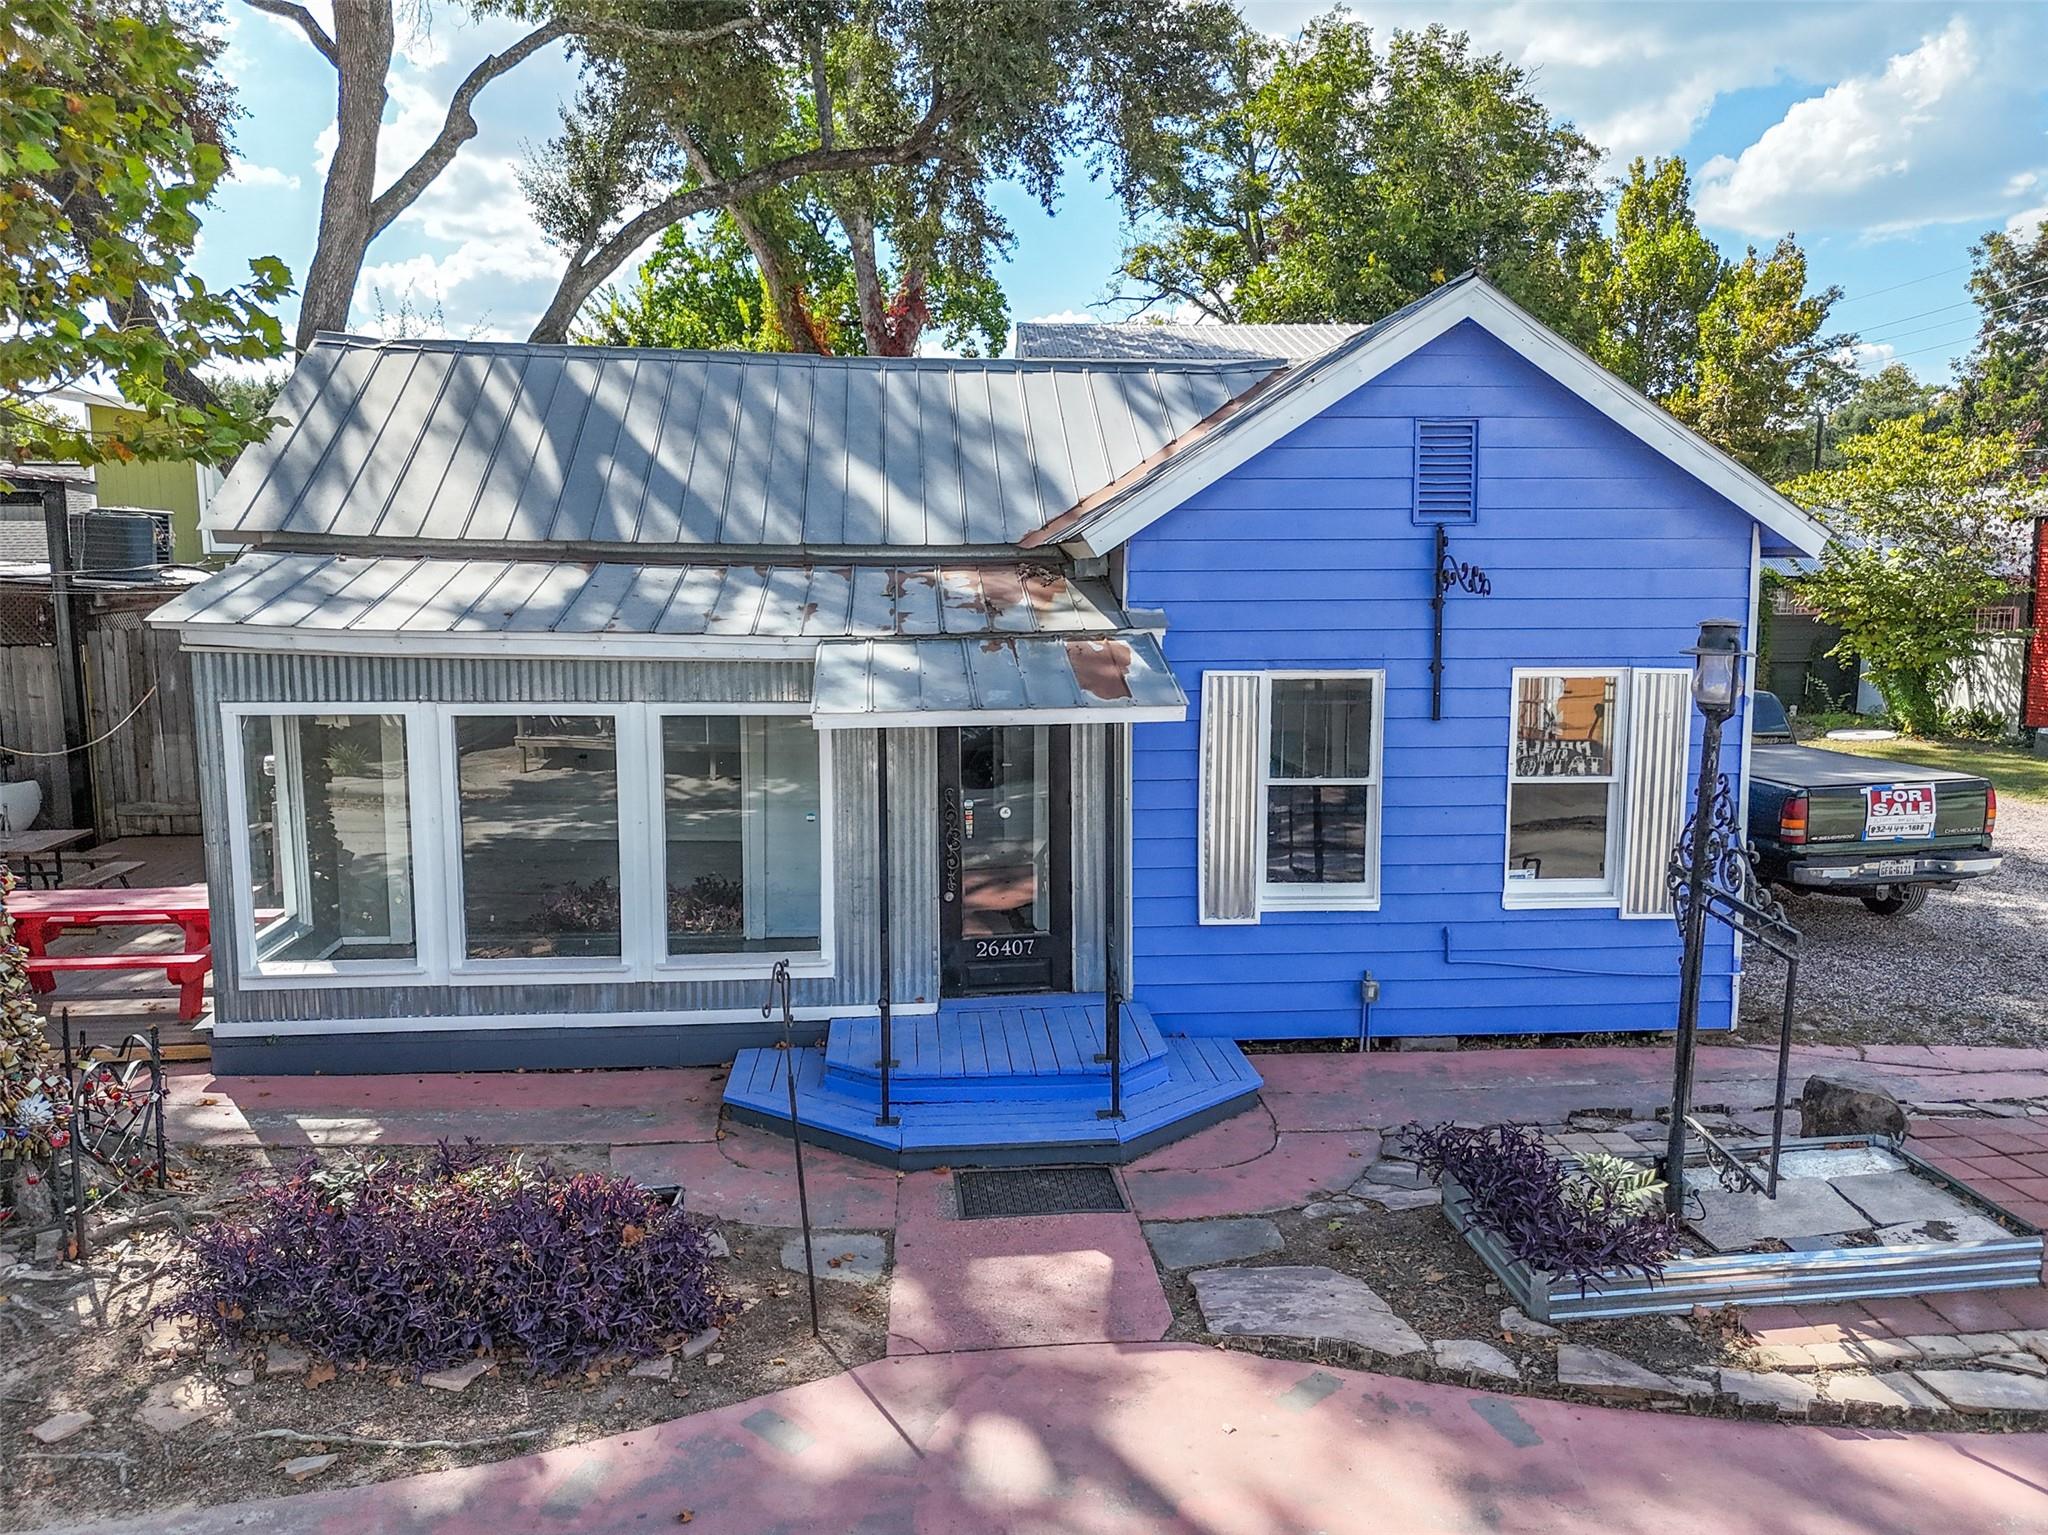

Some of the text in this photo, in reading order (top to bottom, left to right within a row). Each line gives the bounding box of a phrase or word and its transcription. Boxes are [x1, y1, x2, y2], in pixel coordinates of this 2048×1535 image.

[1880, 790, 1922, 803] FOR
[1872, 801, 1932, 816] SALE
[976, 939, 1035, 957] 26407
